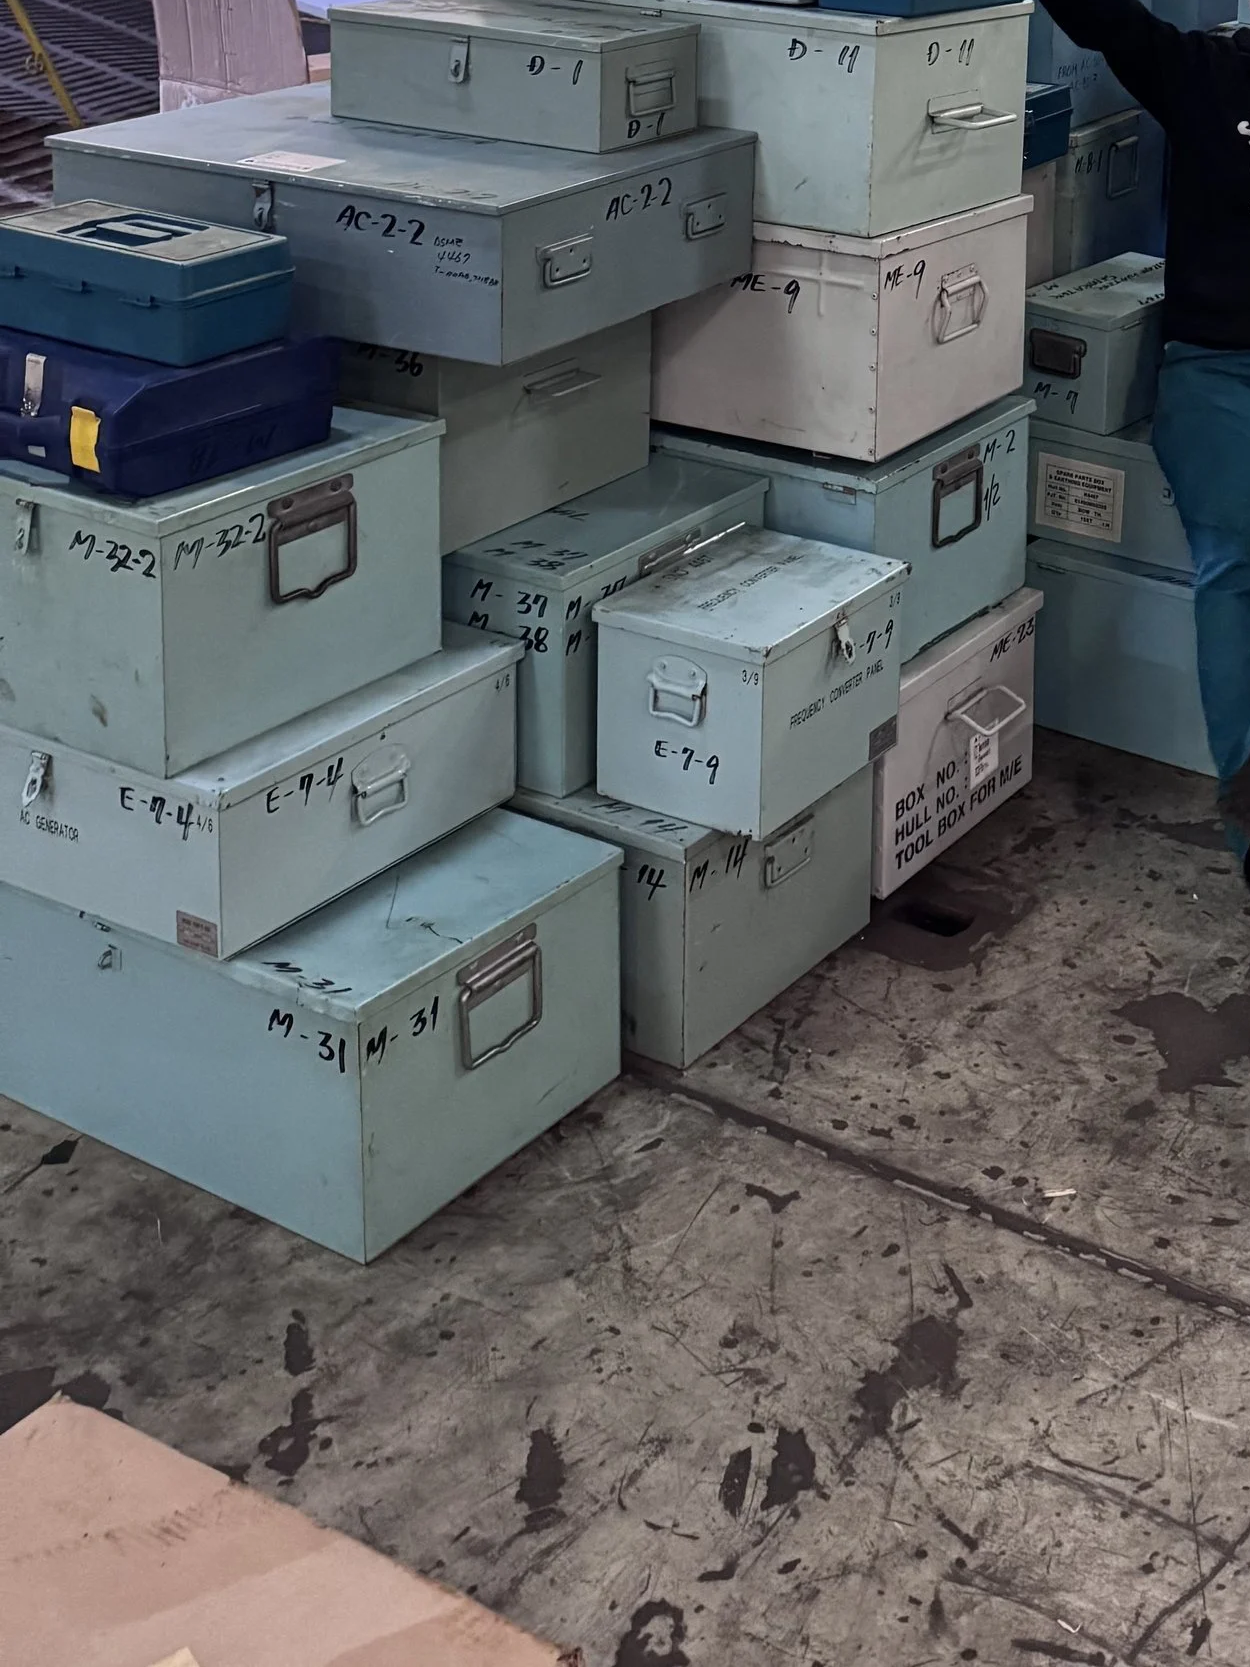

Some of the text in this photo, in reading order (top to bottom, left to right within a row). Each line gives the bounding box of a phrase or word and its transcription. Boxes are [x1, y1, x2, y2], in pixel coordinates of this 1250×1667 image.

[526, 55, 585, 87] D-1
[626, 113, 665, 140] D-1
[605, 177, 673, 221] AC-2-2
[335, 204, 426, 246] AC-2-2
[729, 272, 801, 314] ME-9
[883, 259, 927, 300] ME-9
[983, 429, 1016, 464] M-2
[983, 473, 1001, 522] 1/2
[1074, 474, 1092, 483] PARTS
[1081, 482, 1112, 494] EQUIPMENT
[69, 529, 157, 579] M-32-2
[174, 513, 267, 571] M-32-2
[989, 616, 1035, 663] ME-23
[741, 669, 760, 686] 3/9
[789, 658, 884, 731] FREQUENCY CONVERTER PANEL
[266, 756, 344, 815] E-7-4
[655, 740, 721, 786] E-7-9
[119, 786, 194, 842] E-7-4
[895, 760, 960, 822] BOX NO.
[895, 829, 934, 870] TOOL
[937, 801, 966, 838] BOX
[969, 776, 996, 812] FOR
[999, 754, 1023, 788] M/E
[19, 808, 79, 843] AC GENERATOR
[895, 786, 960, 847] HULL NO.
[688, 837, 752, 894] M-14
[268, 1008, 346, 1074] M-31
[366, 994, 440, 1065] M-31
